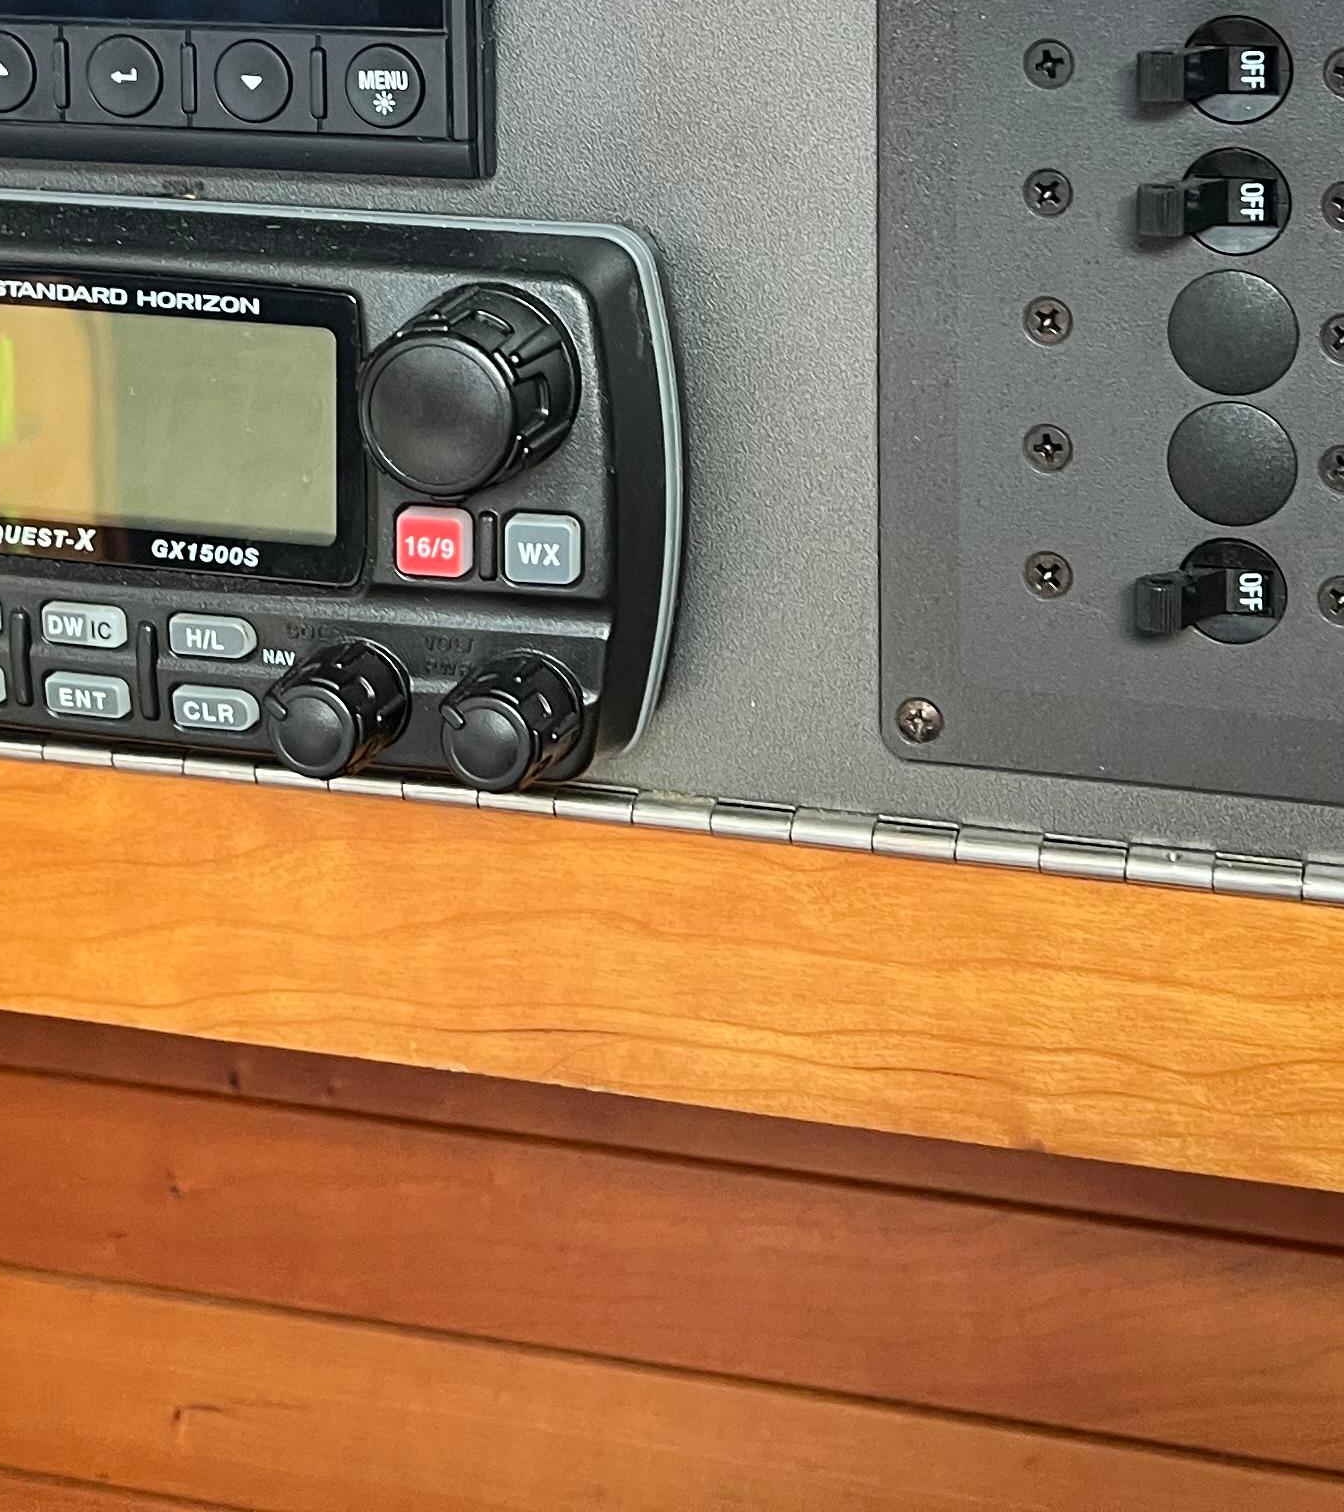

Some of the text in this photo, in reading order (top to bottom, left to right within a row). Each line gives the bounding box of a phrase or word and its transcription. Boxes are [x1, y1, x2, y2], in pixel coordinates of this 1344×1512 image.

[358, 70, 408, 91] MENU
[1241, 50, 1265, 89] OFF
[1240, 182, 1264, 222] OFF
[136, 290, 260, 315] HORIZON
[151, 539, 260, 568] GX1500S
[405, 536, 456, 560] 16/9
[517, 541, 561, 567] WX
[1239, 572, 1263, 611] OFF
[47, 615, 113, 640] DW IC
[185, 627, 225, 651] H/L
[262, 648, 296, 666] NAV
[58, 687, 107, 710] ENT
[183, 700, 234, 724] CLR
